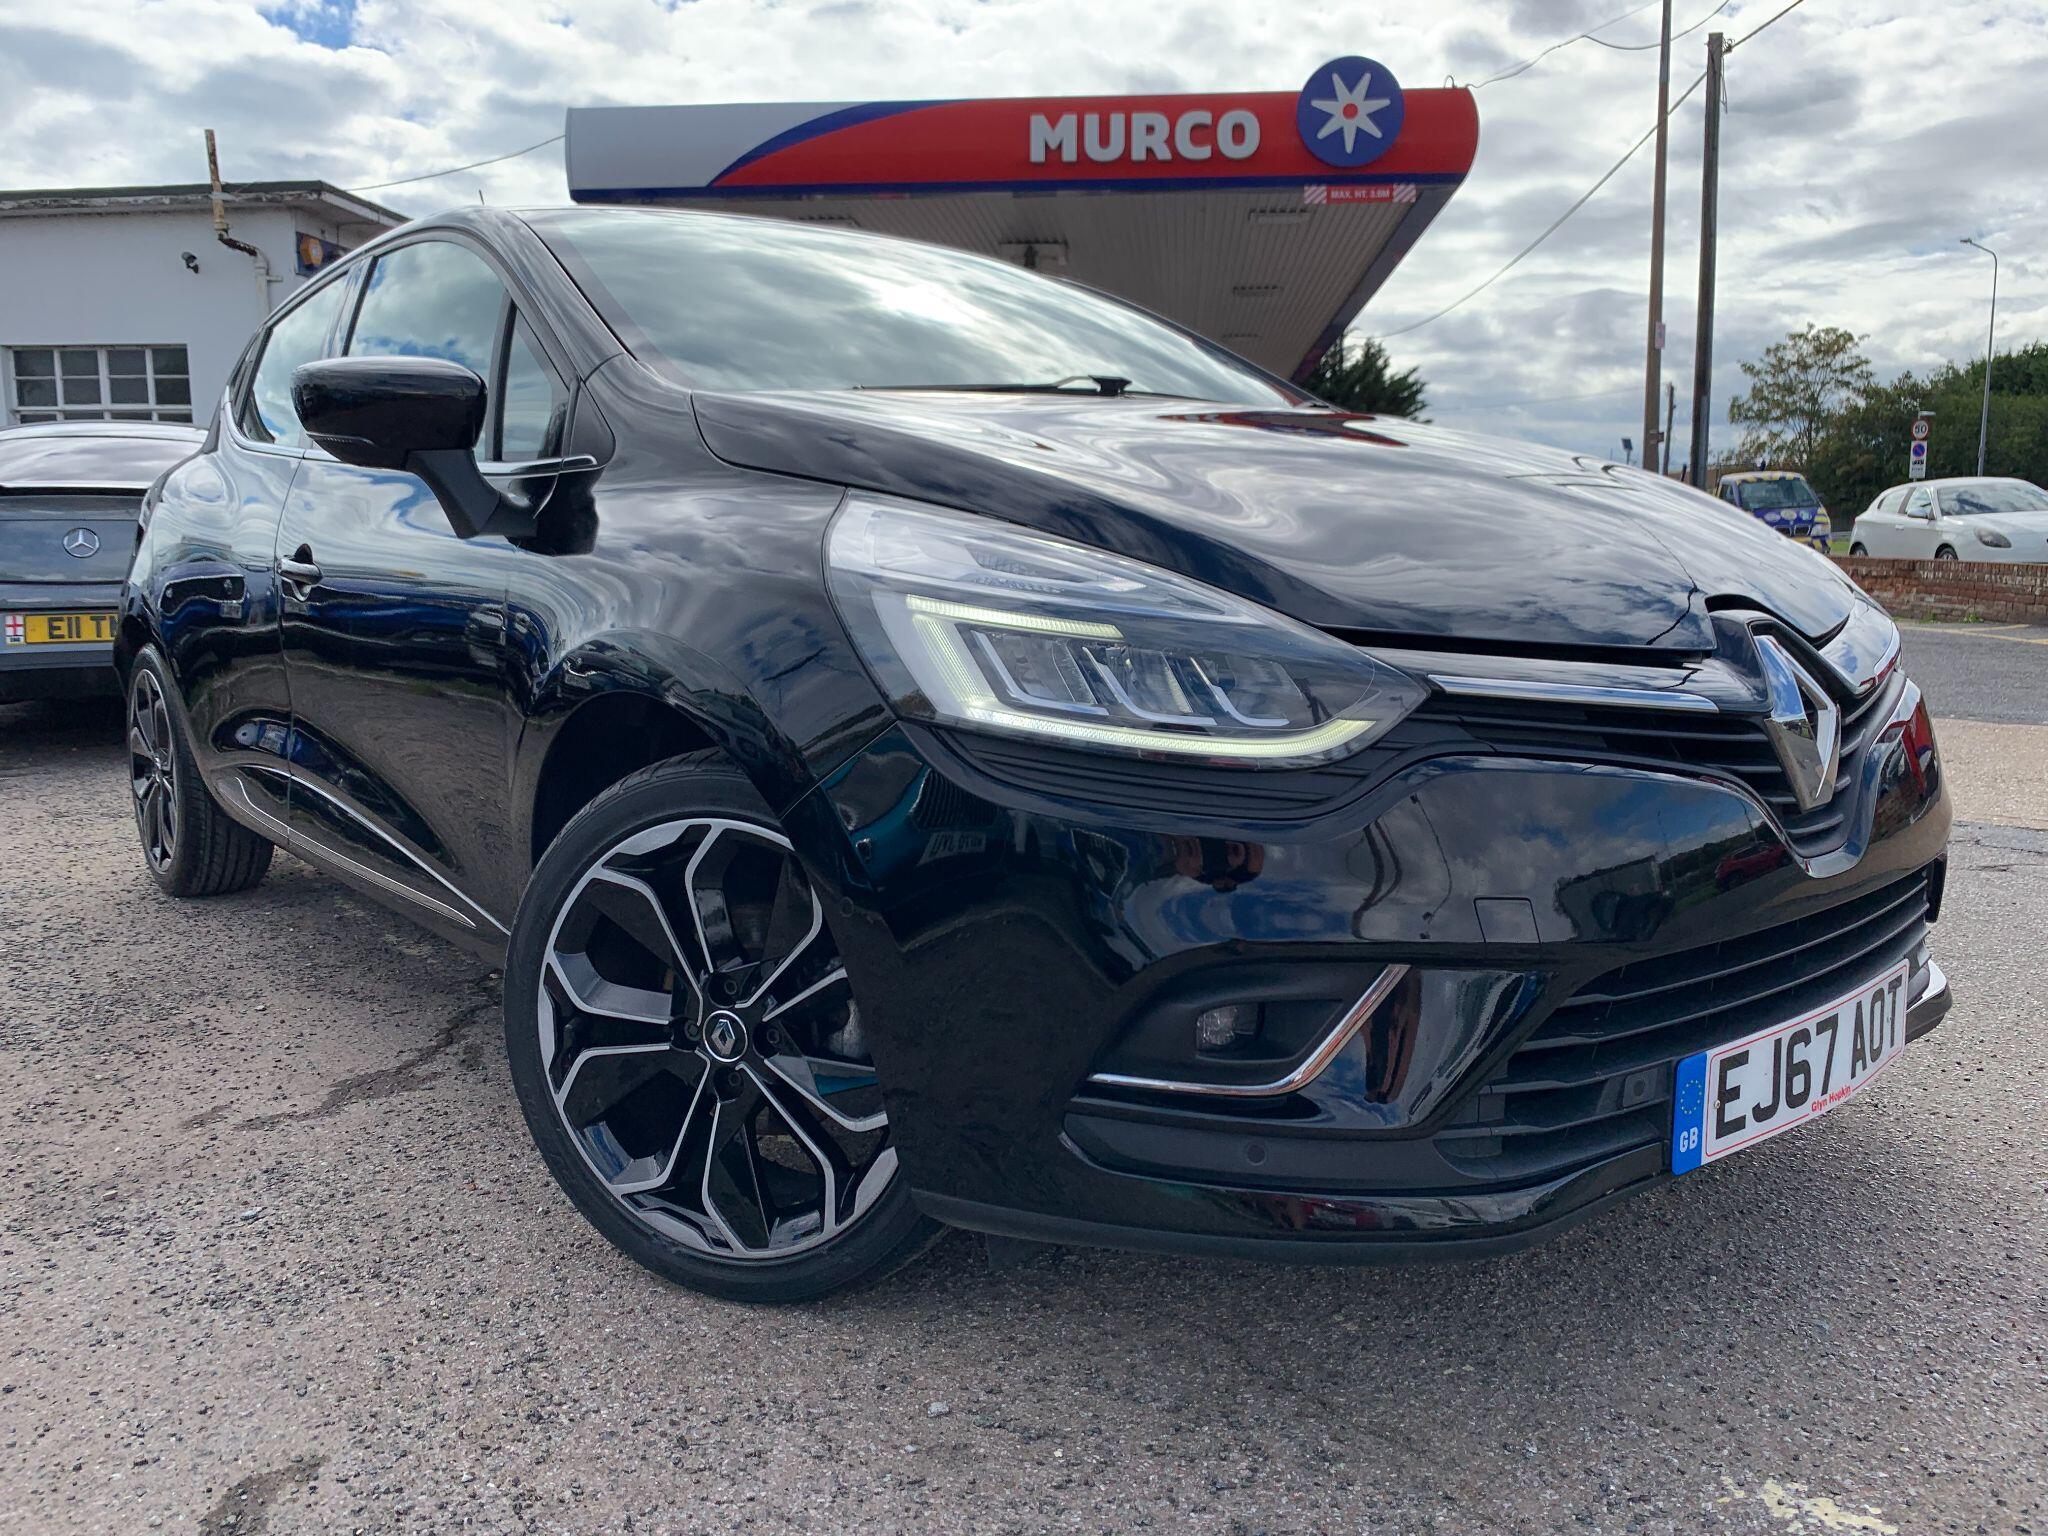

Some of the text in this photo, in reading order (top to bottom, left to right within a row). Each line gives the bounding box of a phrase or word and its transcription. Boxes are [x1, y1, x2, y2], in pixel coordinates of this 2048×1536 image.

[1030, 110, 1261, 163] MURCO
[1331, 190, 1352, 199] MAX.
[1714, 977, 1903, 1140] EJ67 AOT
[1811, 1084, 1852, 1112] Glyn Hopkin
[1679, 1126, 1699, 1153] GB
